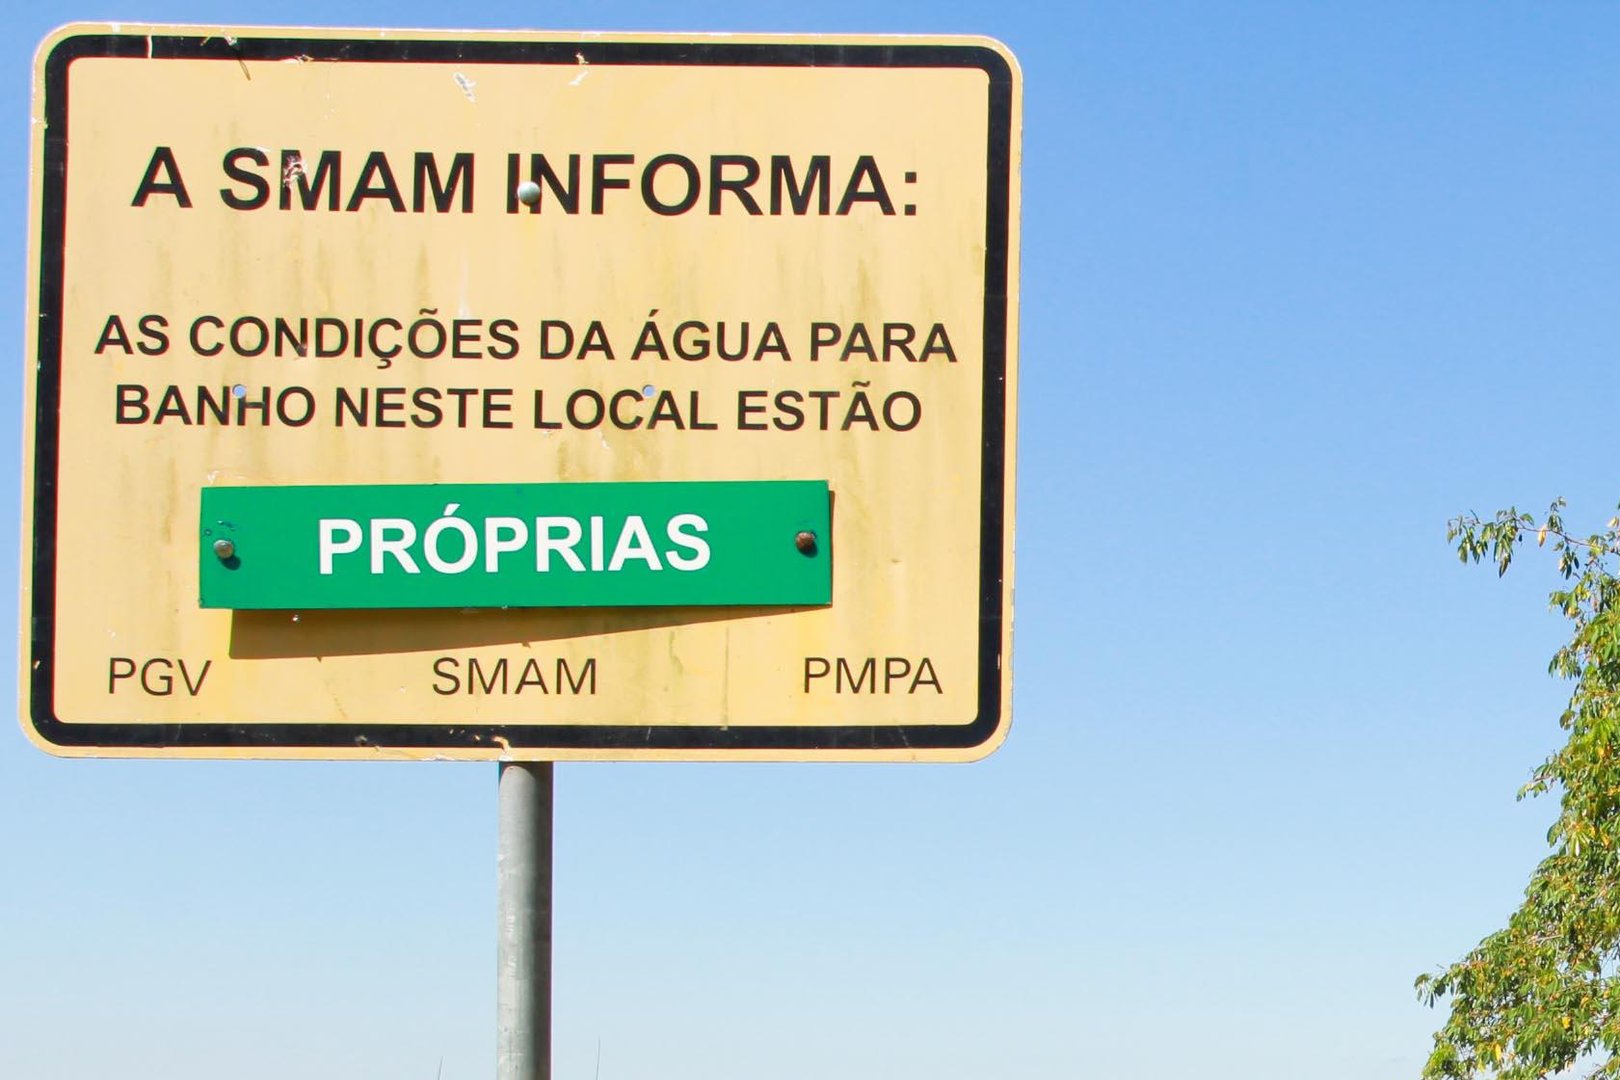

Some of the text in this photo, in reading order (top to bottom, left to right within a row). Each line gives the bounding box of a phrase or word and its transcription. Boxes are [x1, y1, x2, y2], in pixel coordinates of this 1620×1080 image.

[131, 146, 917, 216] A SMAM INFORMA:
[94, 308, 957, 370] AS CONDIÇÕES DA ÁGUA PARA
[115, 381, 921, 432] BANHO NESTE LOCAL ESTÃO
[319, 503, 711, 575] PRÓPRIAS
[109, 657, 211, 696] PGV
[433, 657, 596, 696] SMAM
[804, 657, 943, 694] PMPA
